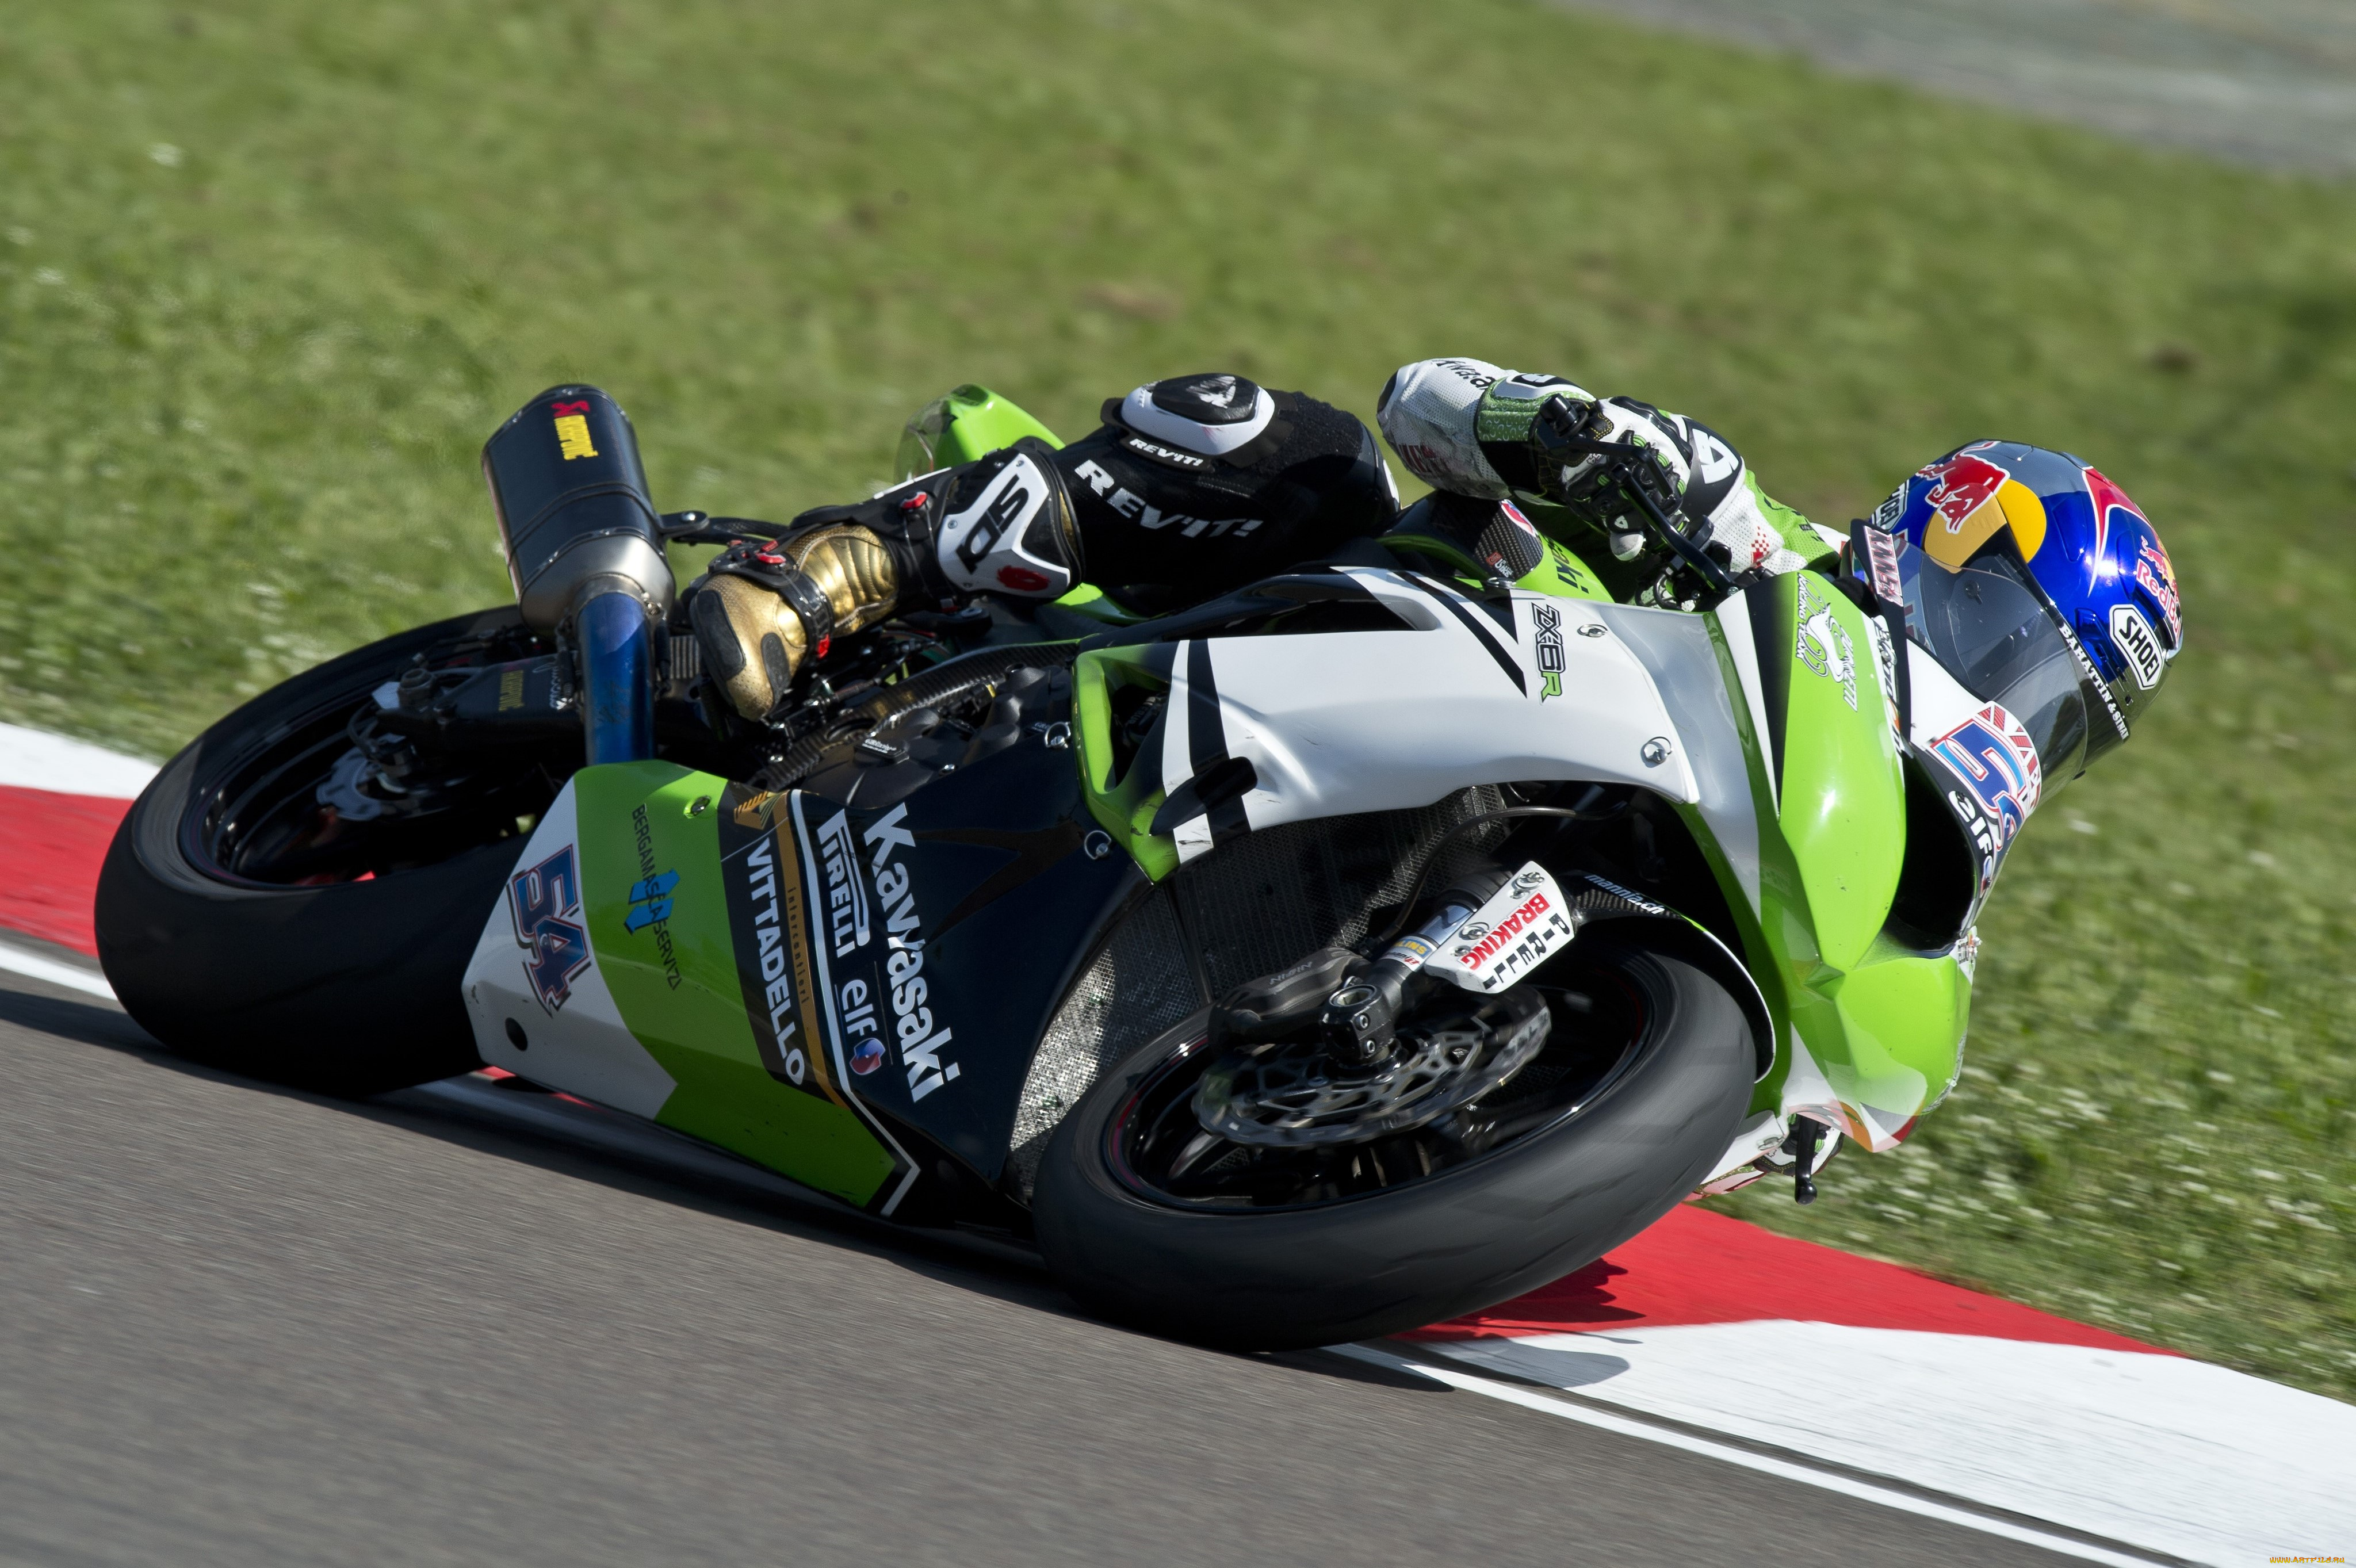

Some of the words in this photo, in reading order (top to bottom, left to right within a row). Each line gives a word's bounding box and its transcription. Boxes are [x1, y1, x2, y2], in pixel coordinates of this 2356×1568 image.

[1074, 460, 1263, 538] REV'IT!
[1796, 622, 1808, 659] TEAM
[2119, 615, 2160, 682] SHOEI
[511, 843, 590, 1004] 54
[632, 803, 665, 921] BERGAMASCA
[653, 917, 682, 990] SERVIZI
[817, 809, 870, 958] PIRELLI
[864, 803, 961, 1103] Kawasaki
[1460, 892, 1551, 971] BRAKING
[747, 837, 805, 1085] VITTADELLO
